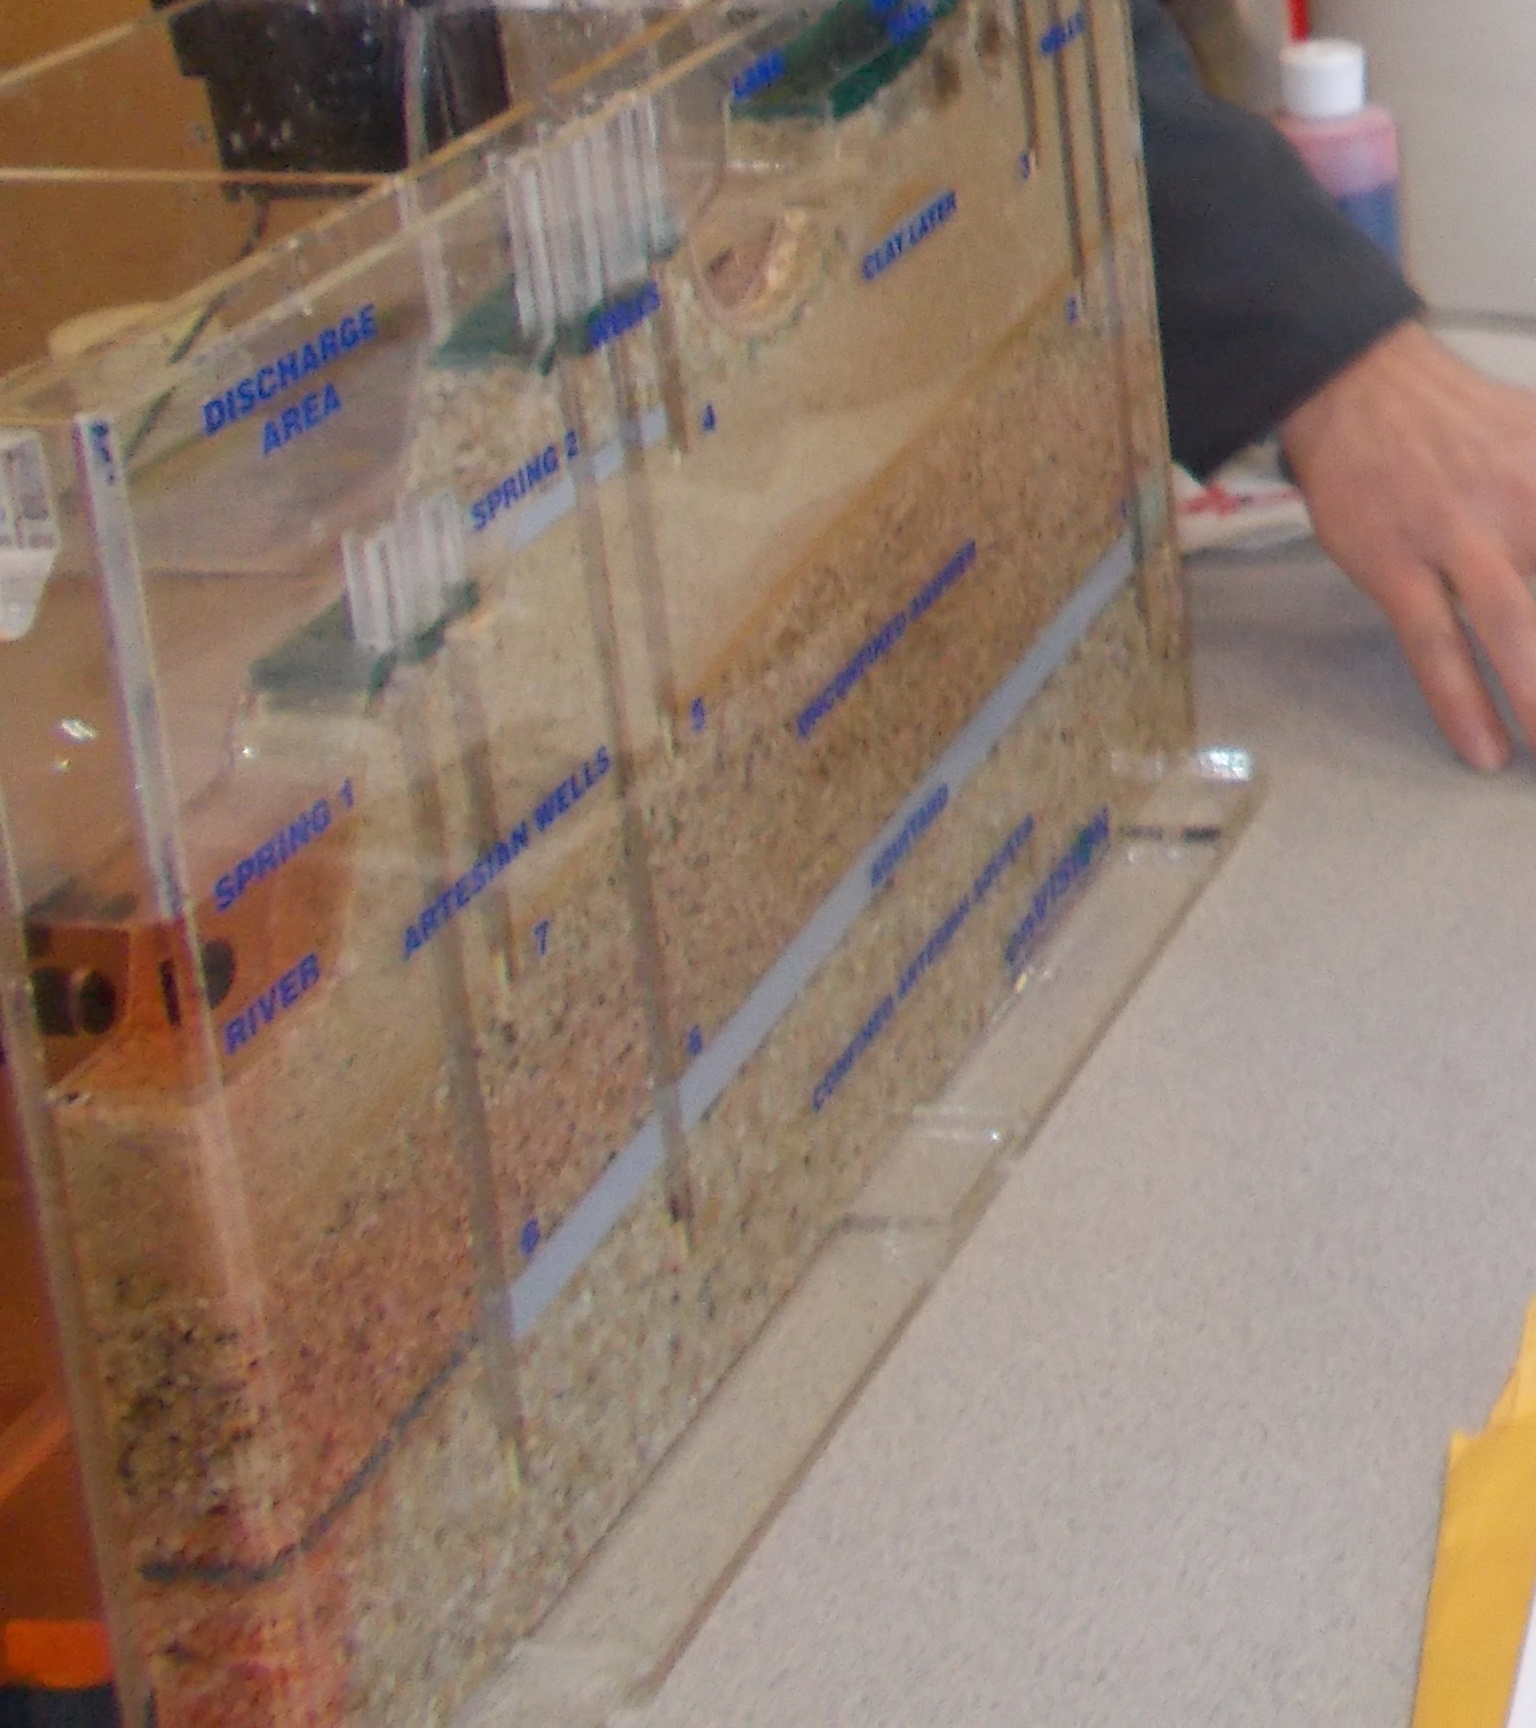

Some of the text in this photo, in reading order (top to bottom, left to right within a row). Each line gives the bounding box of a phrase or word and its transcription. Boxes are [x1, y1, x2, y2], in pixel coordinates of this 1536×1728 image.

[861, 189, 957, 284] CLAY LAYER
[202, 302, 378, 438] DISCHARGE
[261, 382, 343, 459] AREA
[469, 427, 580, 533] SPRING 2
[213, 775, 356, 914] SPRING 1
[402, 744, 612, 963] ARTESIAN WELLS
[531, 919, 550, 957] 7
[223, 950, 321, 1057] RIVER
